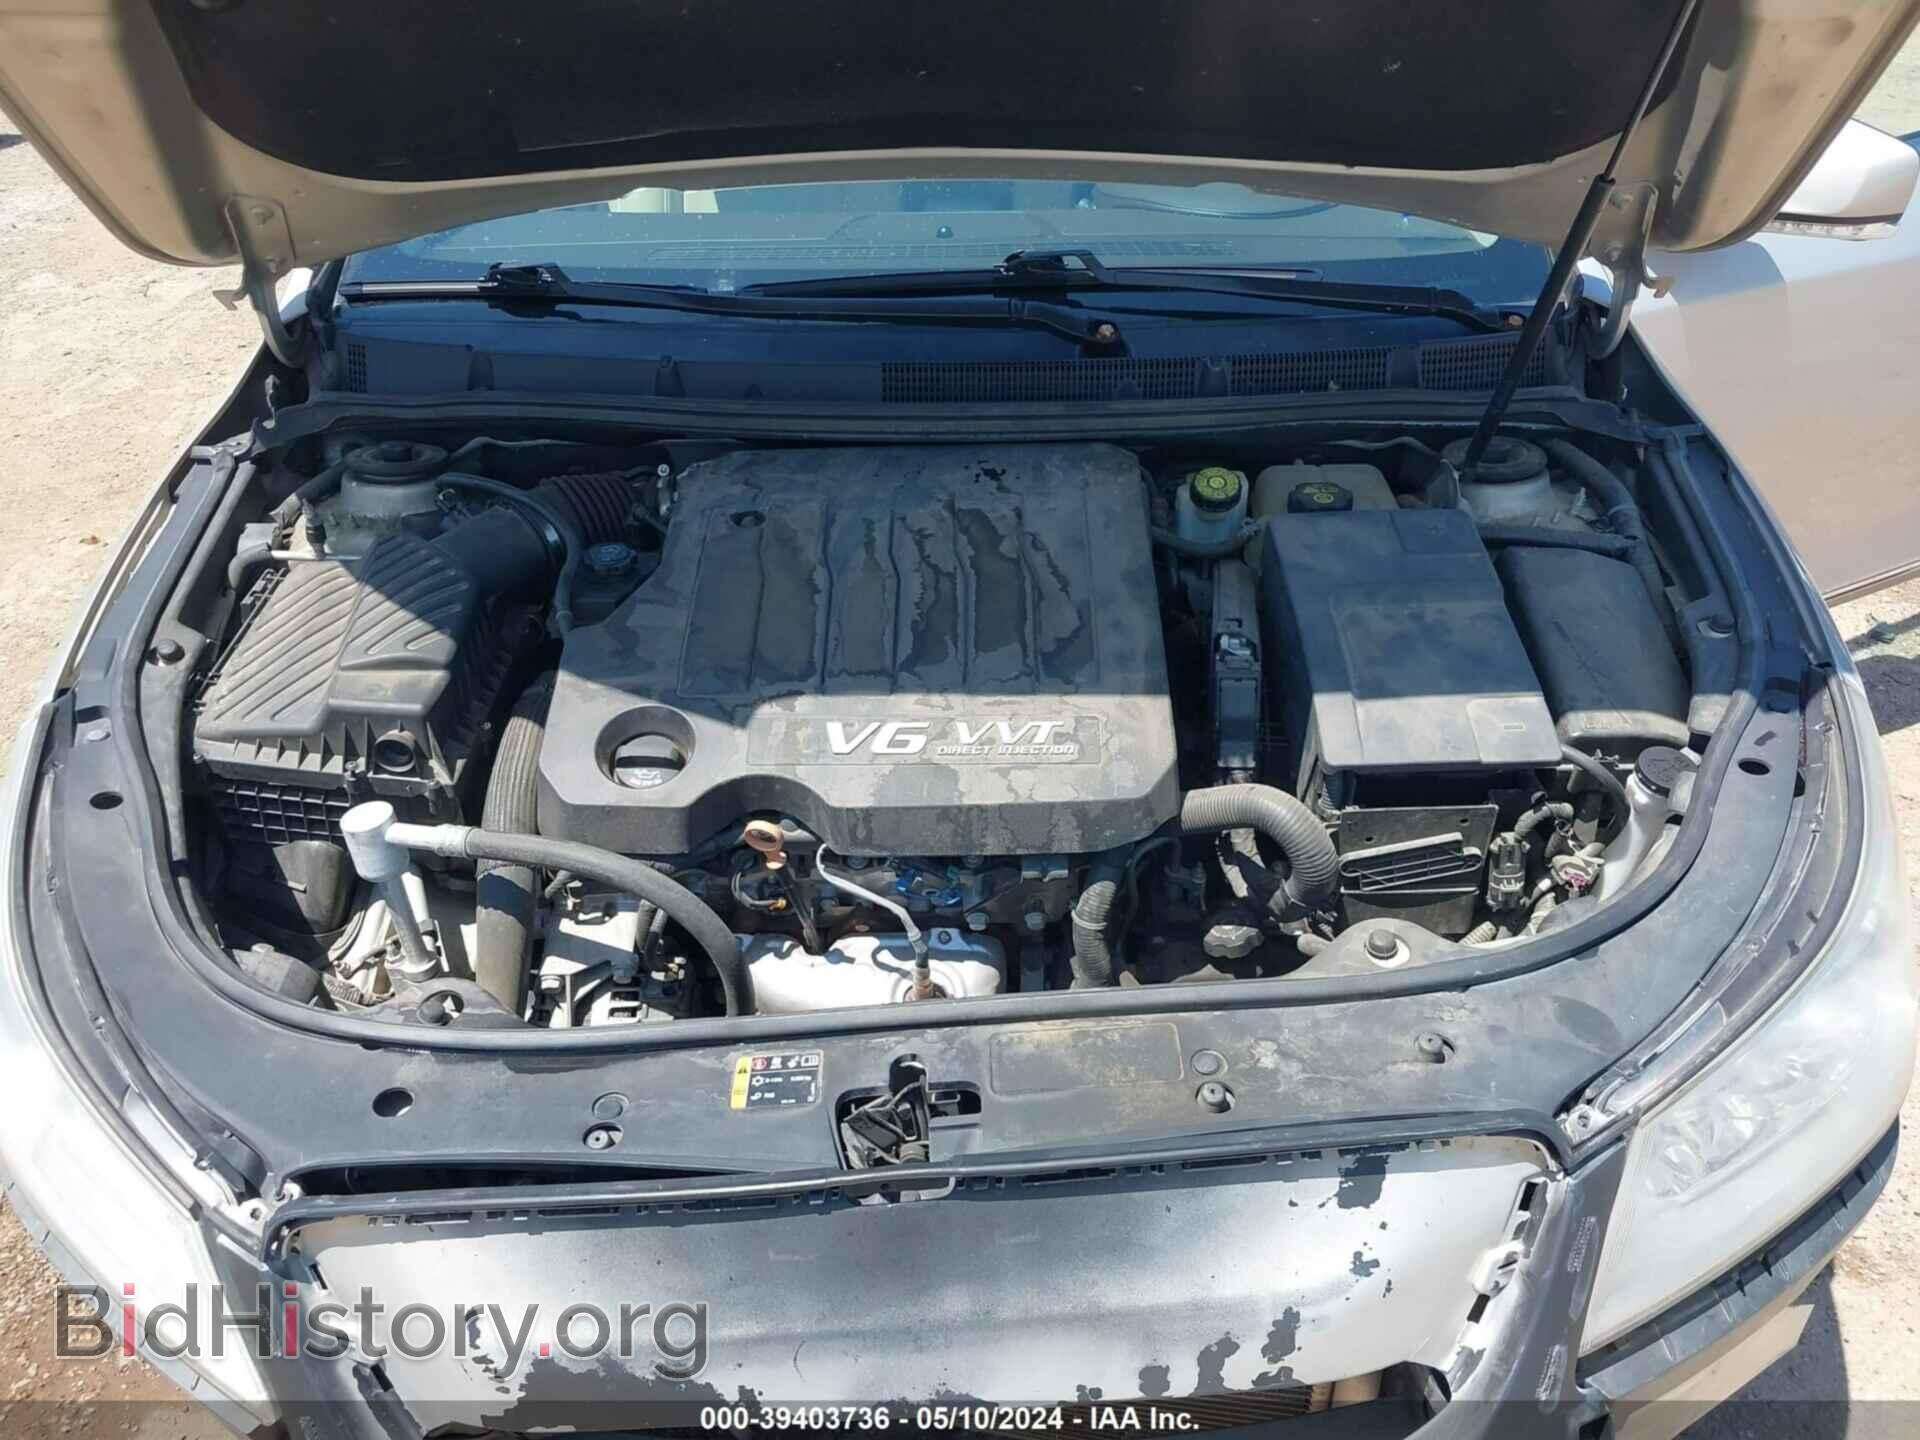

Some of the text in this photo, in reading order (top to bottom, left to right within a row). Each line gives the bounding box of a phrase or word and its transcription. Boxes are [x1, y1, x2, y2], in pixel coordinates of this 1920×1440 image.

[826, 720, 1065, 755] V6 VVT
[936, 744, 1077, 756] DIRECT INJECTION
